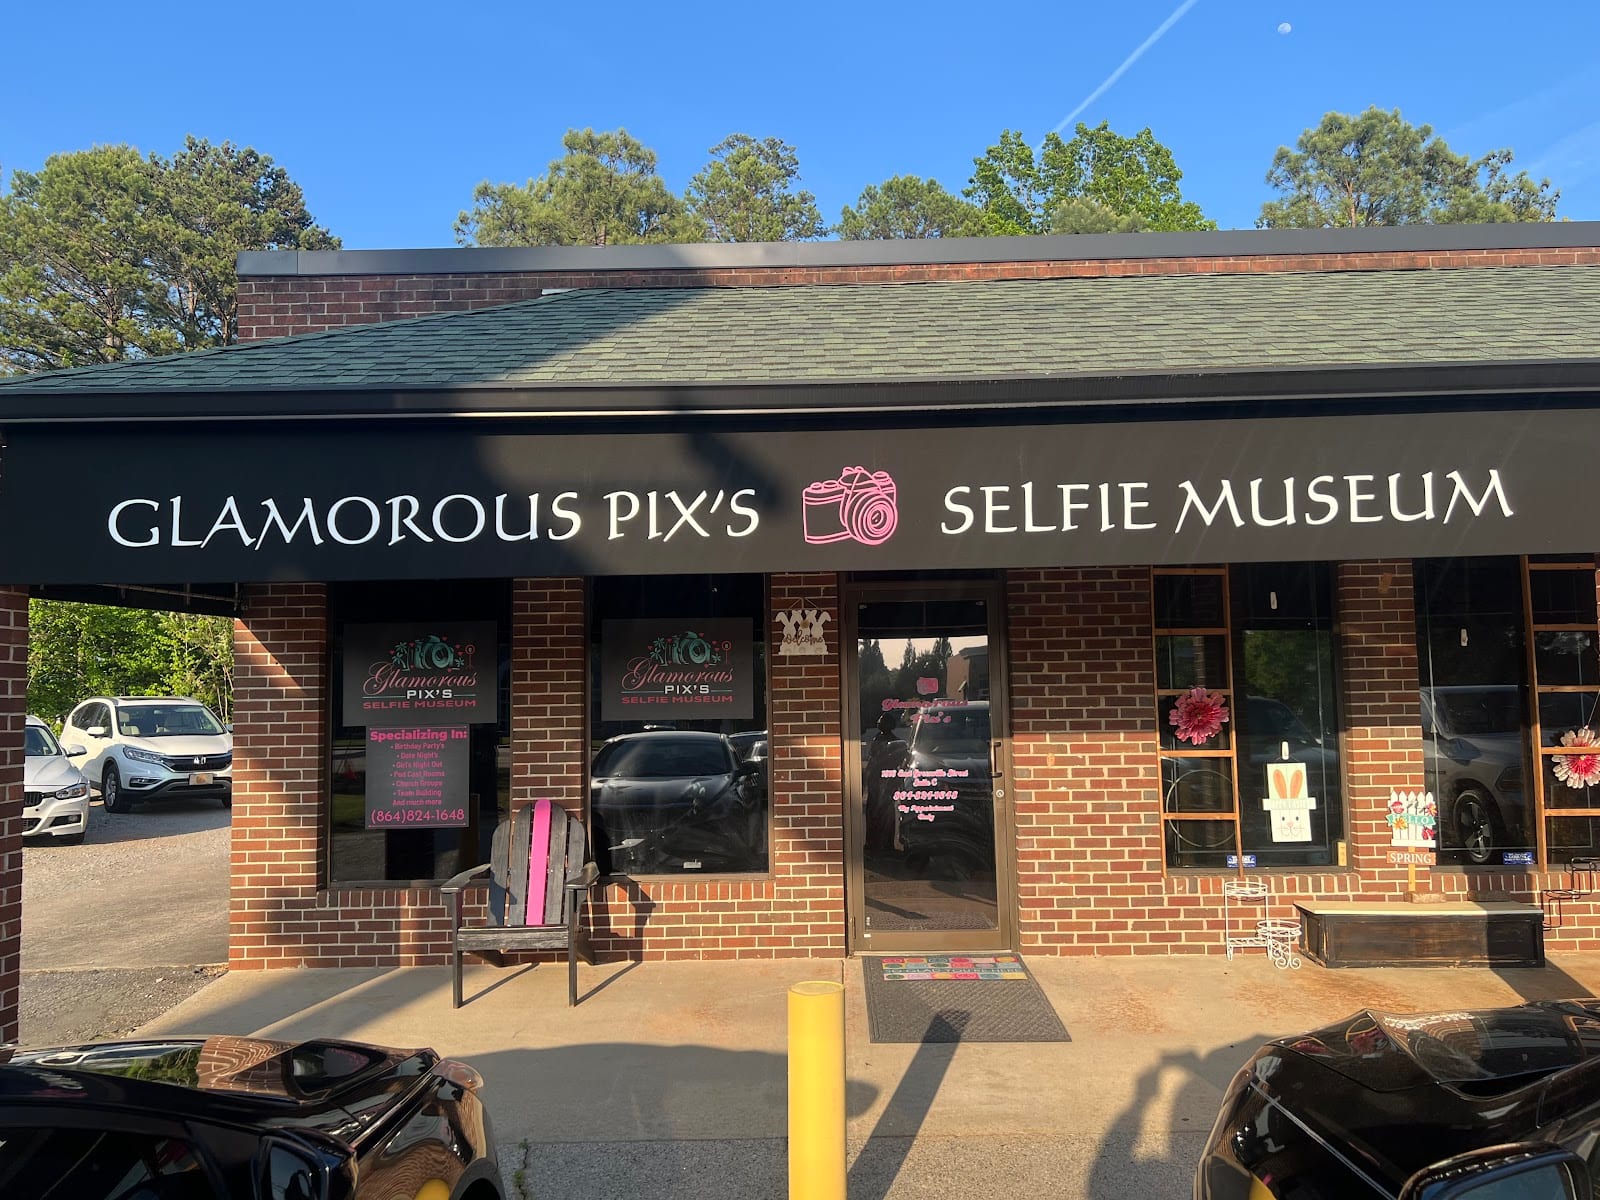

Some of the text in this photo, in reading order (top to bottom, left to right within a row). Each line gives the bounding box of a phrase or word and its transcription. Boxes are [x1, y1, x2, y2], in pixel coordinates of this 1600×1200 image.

[939, 468, 1514, 535] SELFIE MUSEUM
[108, 488, 760, 550] GLAMOROUS PIX'S
[362, 661, 477, 696] Glamorous
[621, 657, 734, 690] Glamorous
[406, 689, 453, 700] PIX'S
[664, 684, 710, 695] PIX'S
[363, 699, 477, 710] SELFIE MUSEUM
[621, 695, 734, 705] SELFIE MUSEUM
[370, 729, 468, 742] Specializing In:
[395, 742, 445, 751] Birthday Party's
[416, 789, 441, 797] Building
[371, 808, 465, 824] (864)824-1648
[1390, 852, 1432, 864] SPRING
